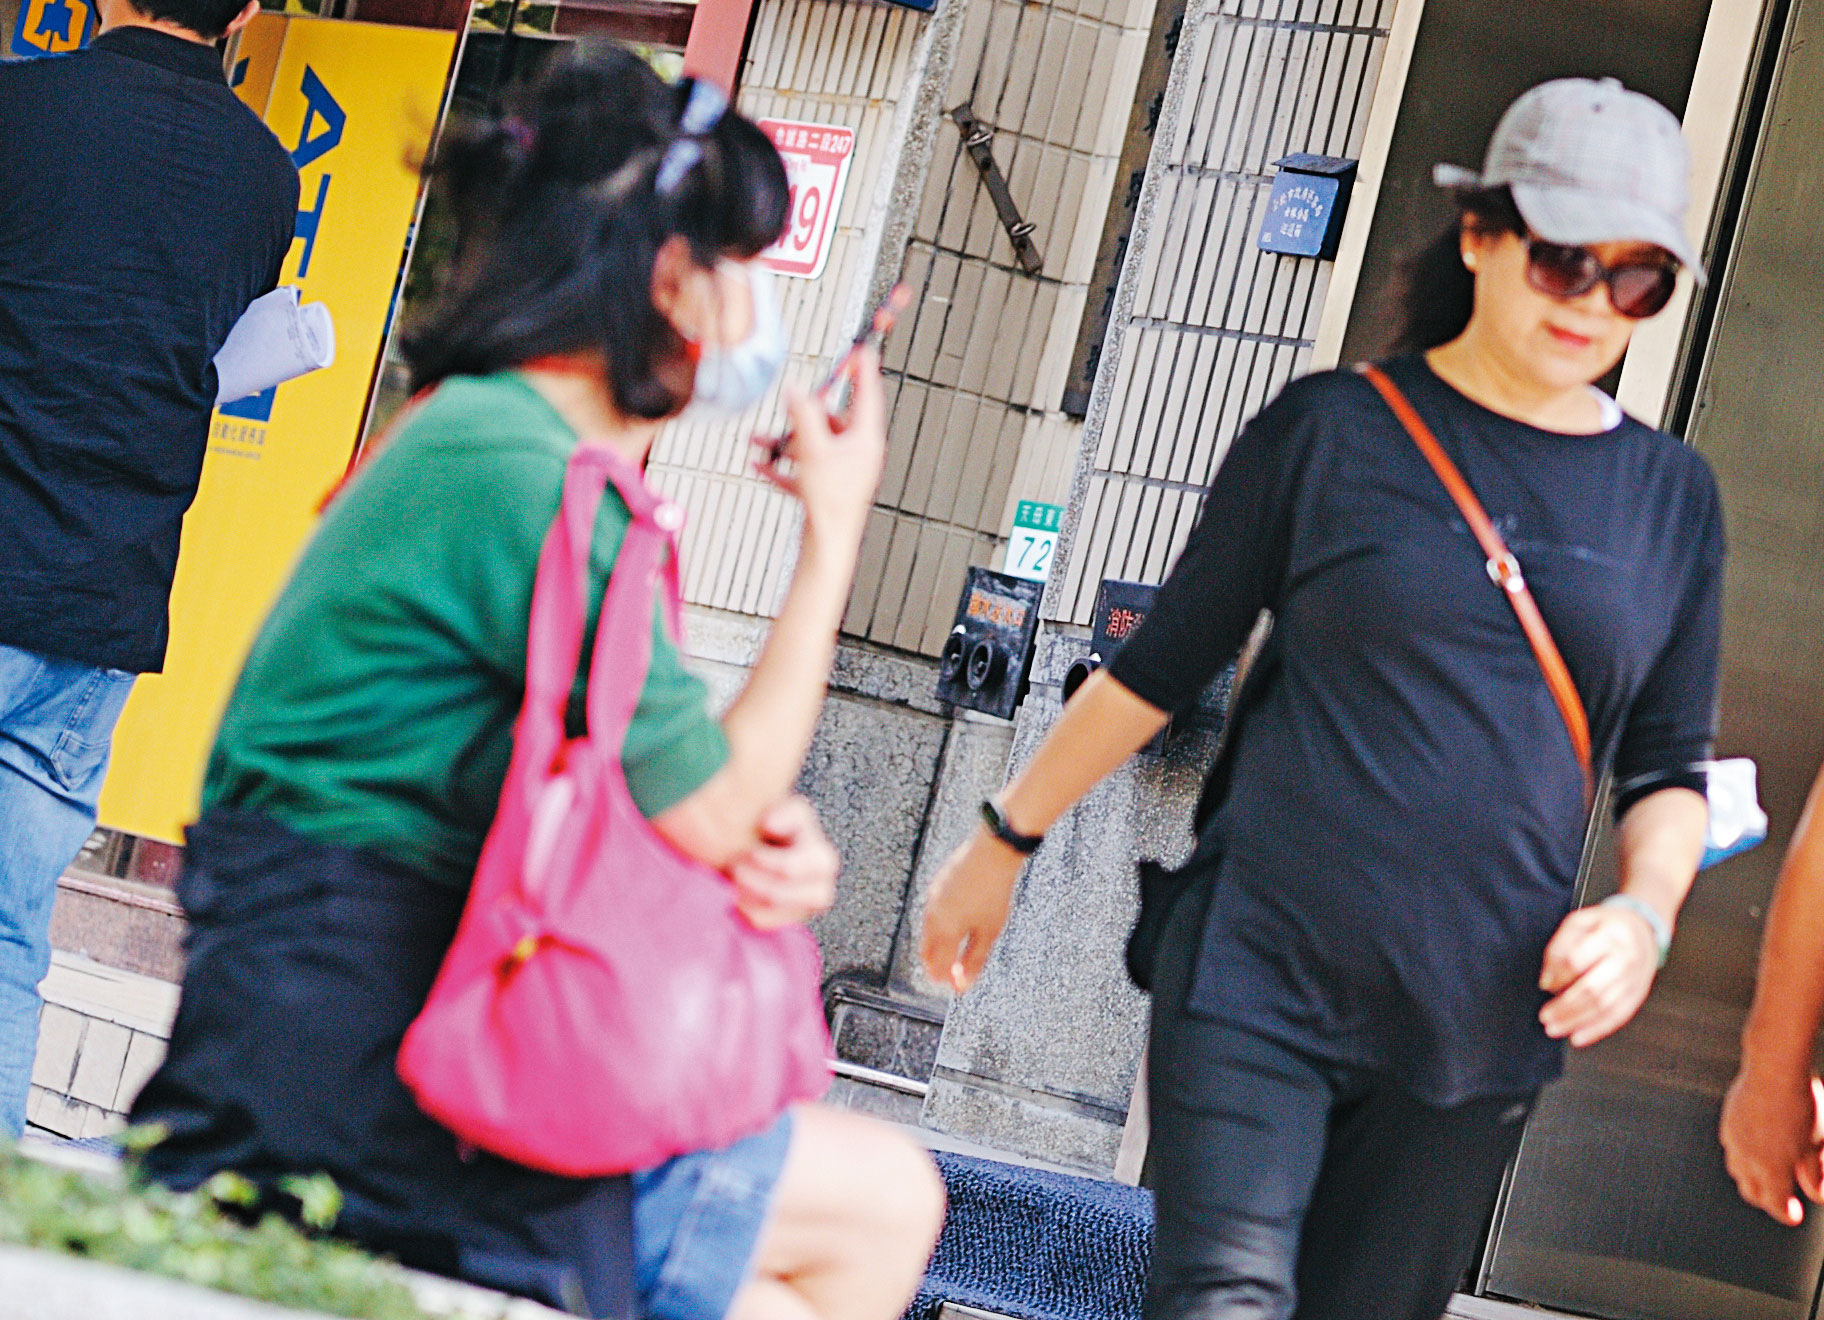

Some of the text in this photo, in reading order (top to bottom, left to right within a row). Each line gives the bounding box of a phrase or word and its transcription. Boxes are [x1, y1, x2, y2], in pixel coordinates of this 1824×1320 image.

[1019, 505, 1065, 528] 天母東
[1017, 536, 1052, 572] 72
